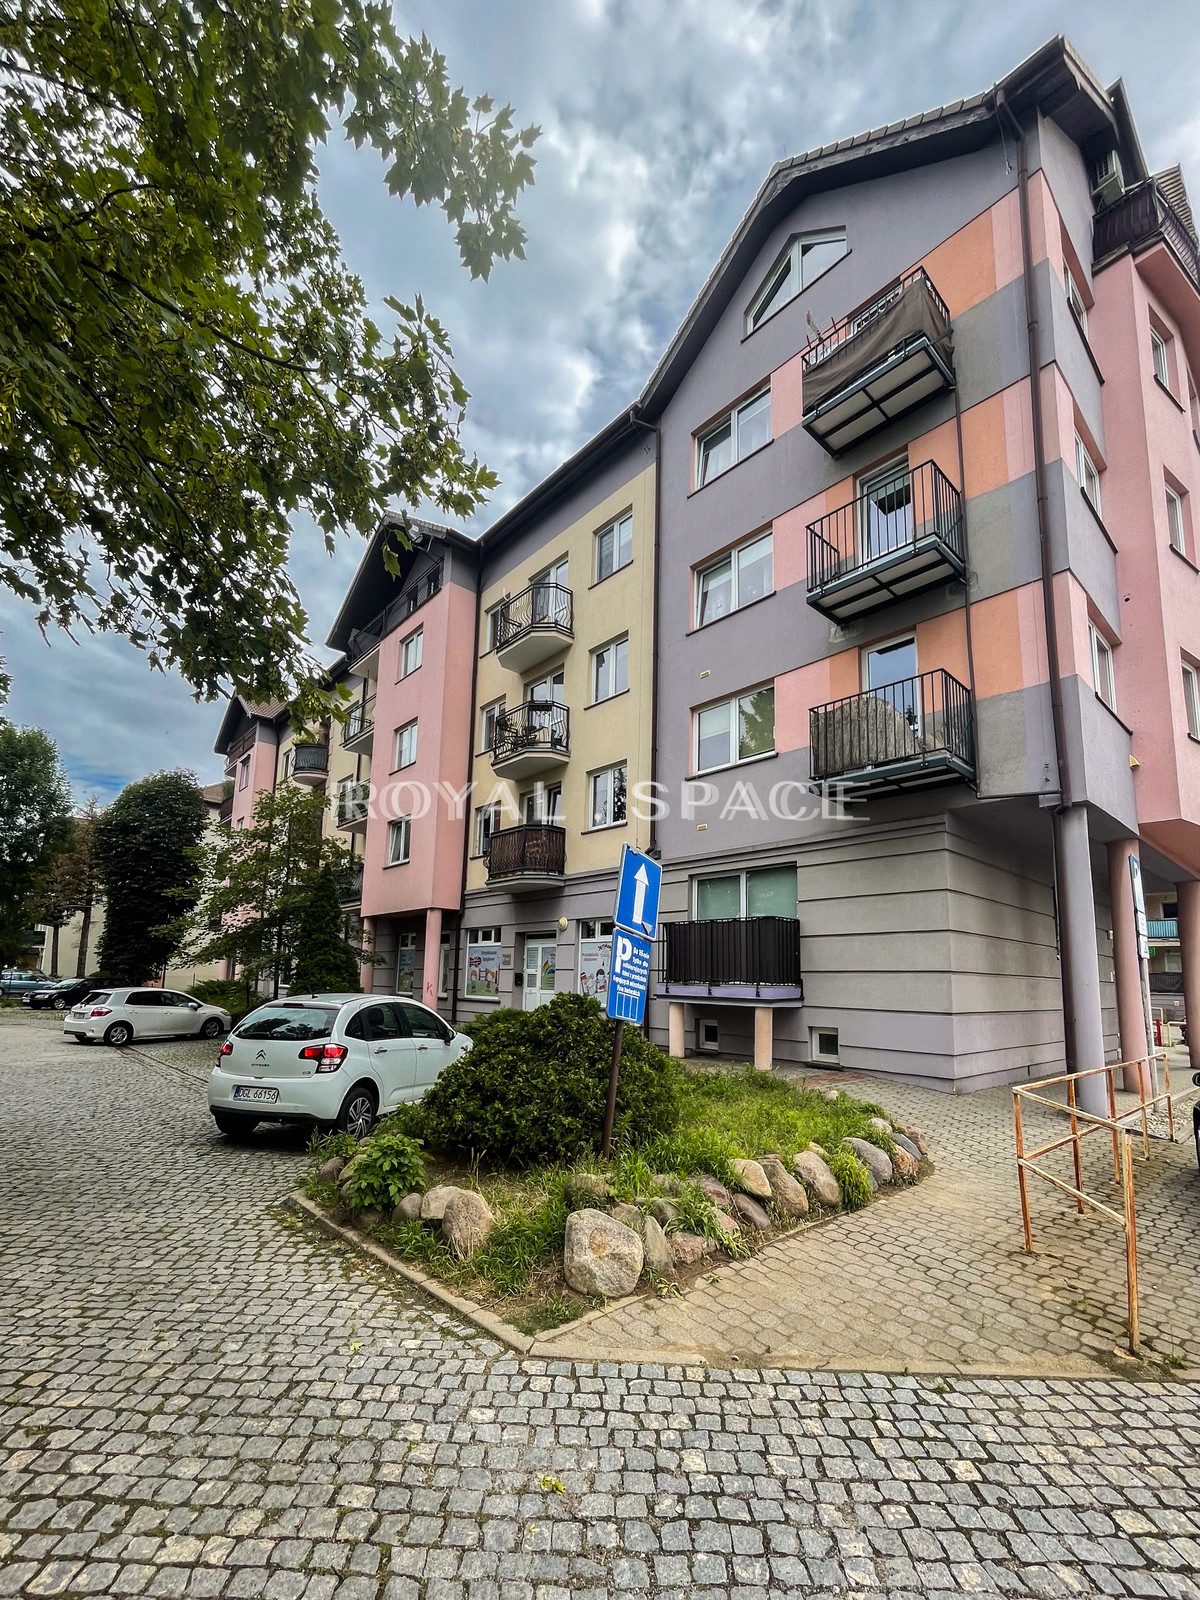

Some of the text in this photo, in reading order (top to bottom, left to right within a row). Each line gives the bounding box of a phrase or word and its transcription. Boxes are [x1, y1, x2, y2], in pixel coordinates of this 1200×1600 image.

[615, 935, 632, 973] P
[239, 1088, 278, 1100] DGL 66156
